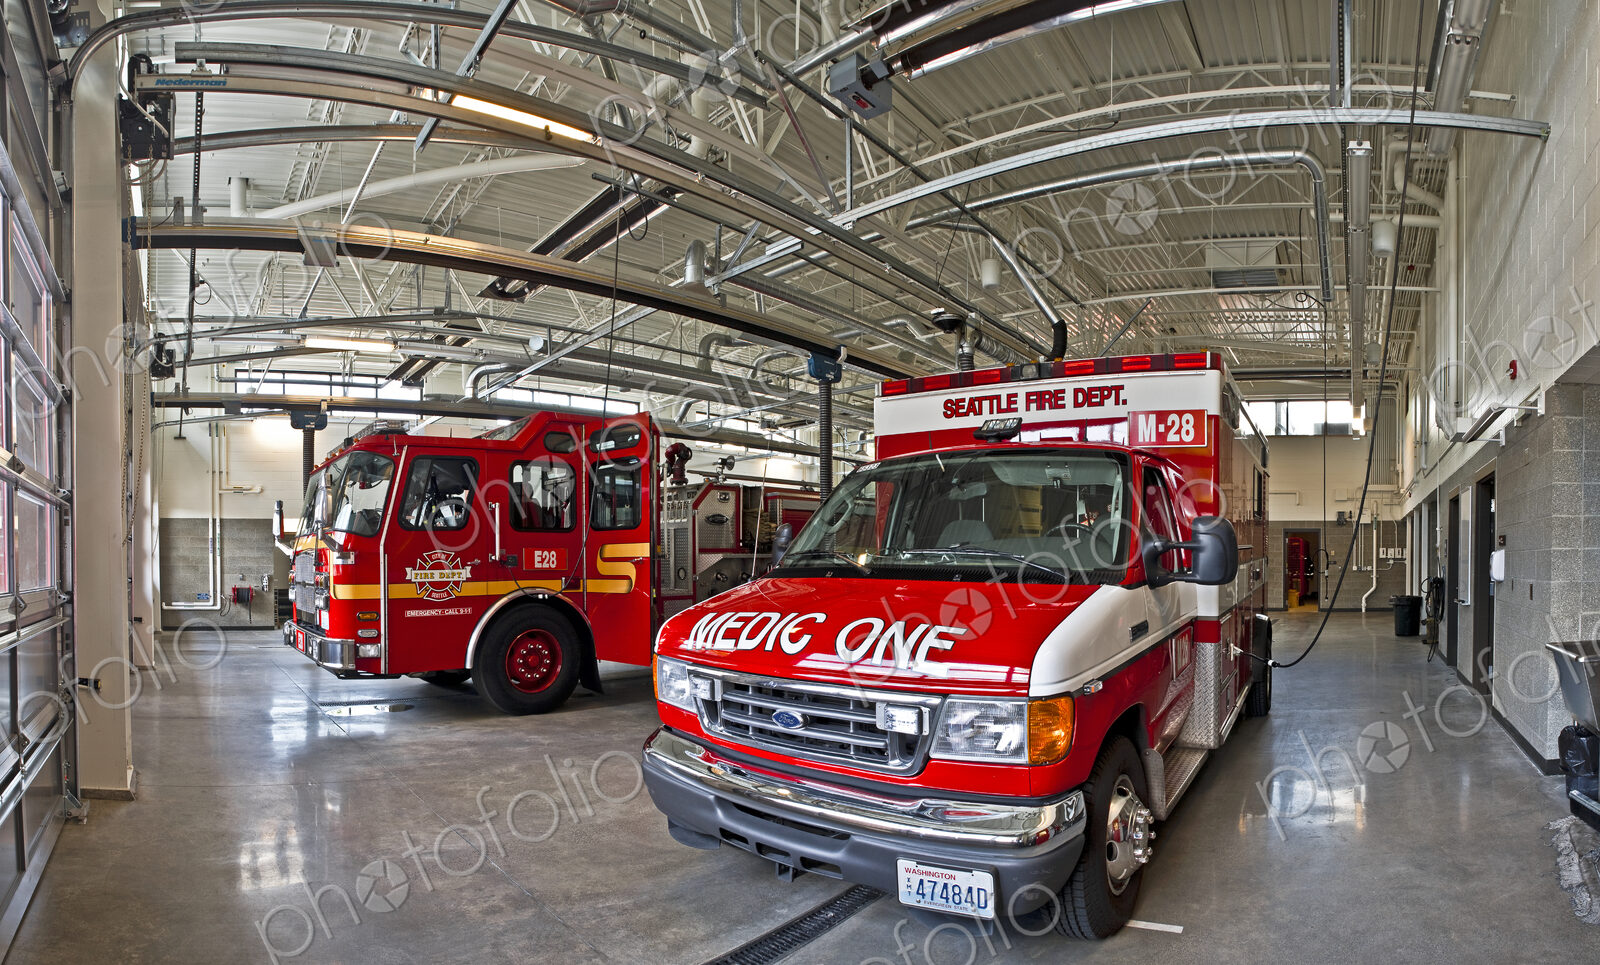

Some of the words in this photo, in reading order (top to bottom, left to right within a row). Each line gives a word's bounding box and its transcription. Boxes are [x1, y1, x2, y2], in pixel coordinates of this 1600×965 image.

[155, 78, 227, 87] Nederman
[942, 392, 1018, 419] SEATTLE
[1025, 388, 1066, 412] FIRE
[1073, 384, 1128, 409] DEPT.
[1137, 412, 1195, 443] M-28
[534, 550, 557, 568] E28
[414, 572, 435, 580] FIRE
[438, 571, 465, 580] DEPT.
[686, 611, 828, 656] MEDIC
[834, 616, 969, 678] ONE
[904, 867, 956, 881] WASHINGTON
[916, 878, 988, 910] 47484D
[923, 900, 952, 909] EVERGREEN
